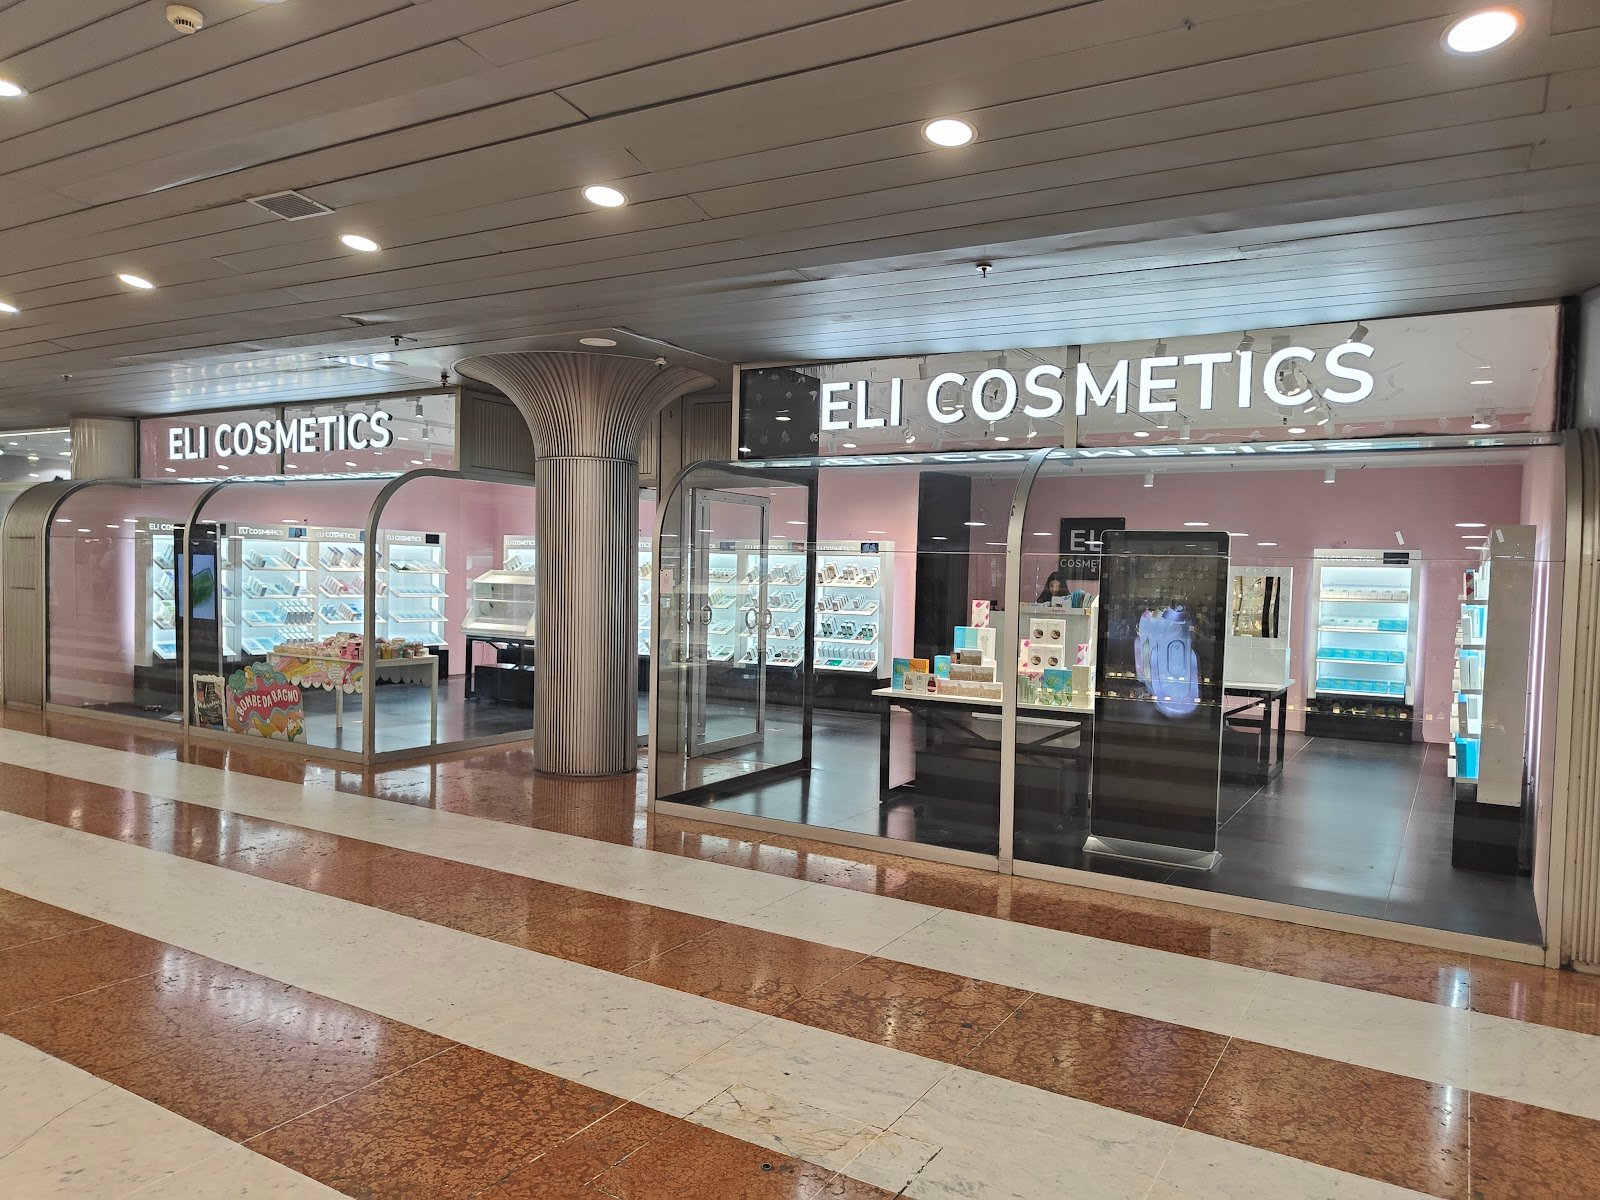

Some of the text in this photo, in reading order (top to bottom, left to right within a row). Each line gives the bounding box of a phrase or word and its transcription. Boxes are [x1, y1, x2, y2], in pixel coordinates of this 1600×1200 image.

[820, 341, 1376, 431] ELI COSMETICS
[169, 411, 393, 460] ELI COSMETICS
[325, 531, 357, 539] COSMETICS
[394, 534, 423, 542] COSMETICS
[1070, 529, 1101, 551] EL
[236, 689, 299, 716] BOMBE DA BAGNO
